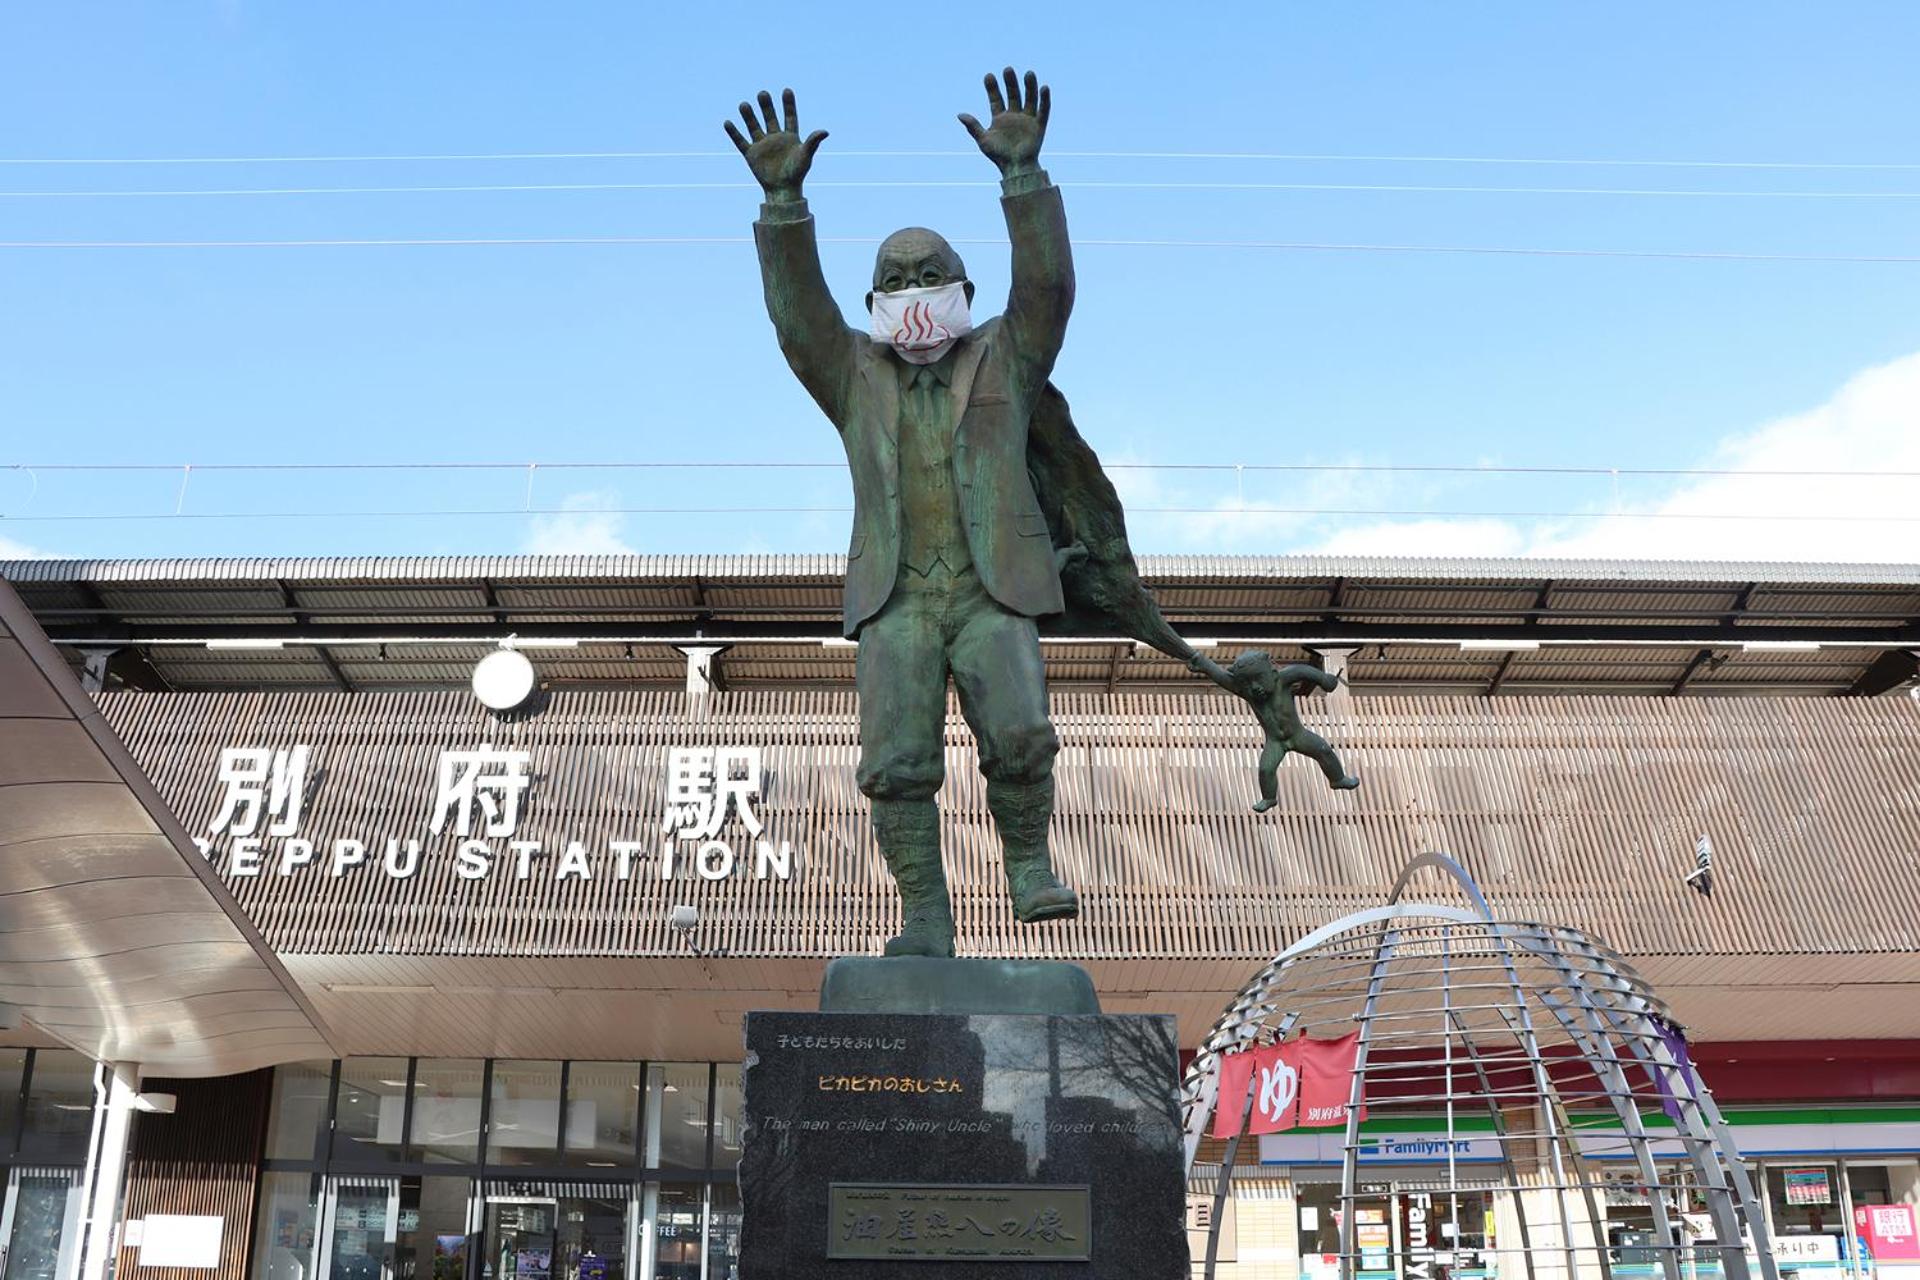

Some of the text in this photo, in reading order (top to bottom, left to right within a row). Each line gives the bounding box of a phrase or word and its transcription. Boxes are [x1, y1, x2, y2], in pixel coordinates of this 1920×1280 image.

[209, 744, 764, 839] 別府駅
[457, 839, 791, 880] STATION
[818, 1075, 963, 1093] ピカピカのおじさん
[1259, 1058, 1298, 1122] ゆ
[762, 1116, 792, 1130] The
[798, 1119, 830, 1131] man
[836, 1117, 887, 1131] called
[1048, 1120, 1096, 1134] loved
[1384, 1138, 1471, 1155] FamilyMrt
[638, 1223, 677, 1237] CFEE
[840, 1205, 1077, 1242] 油屋熊八の像
